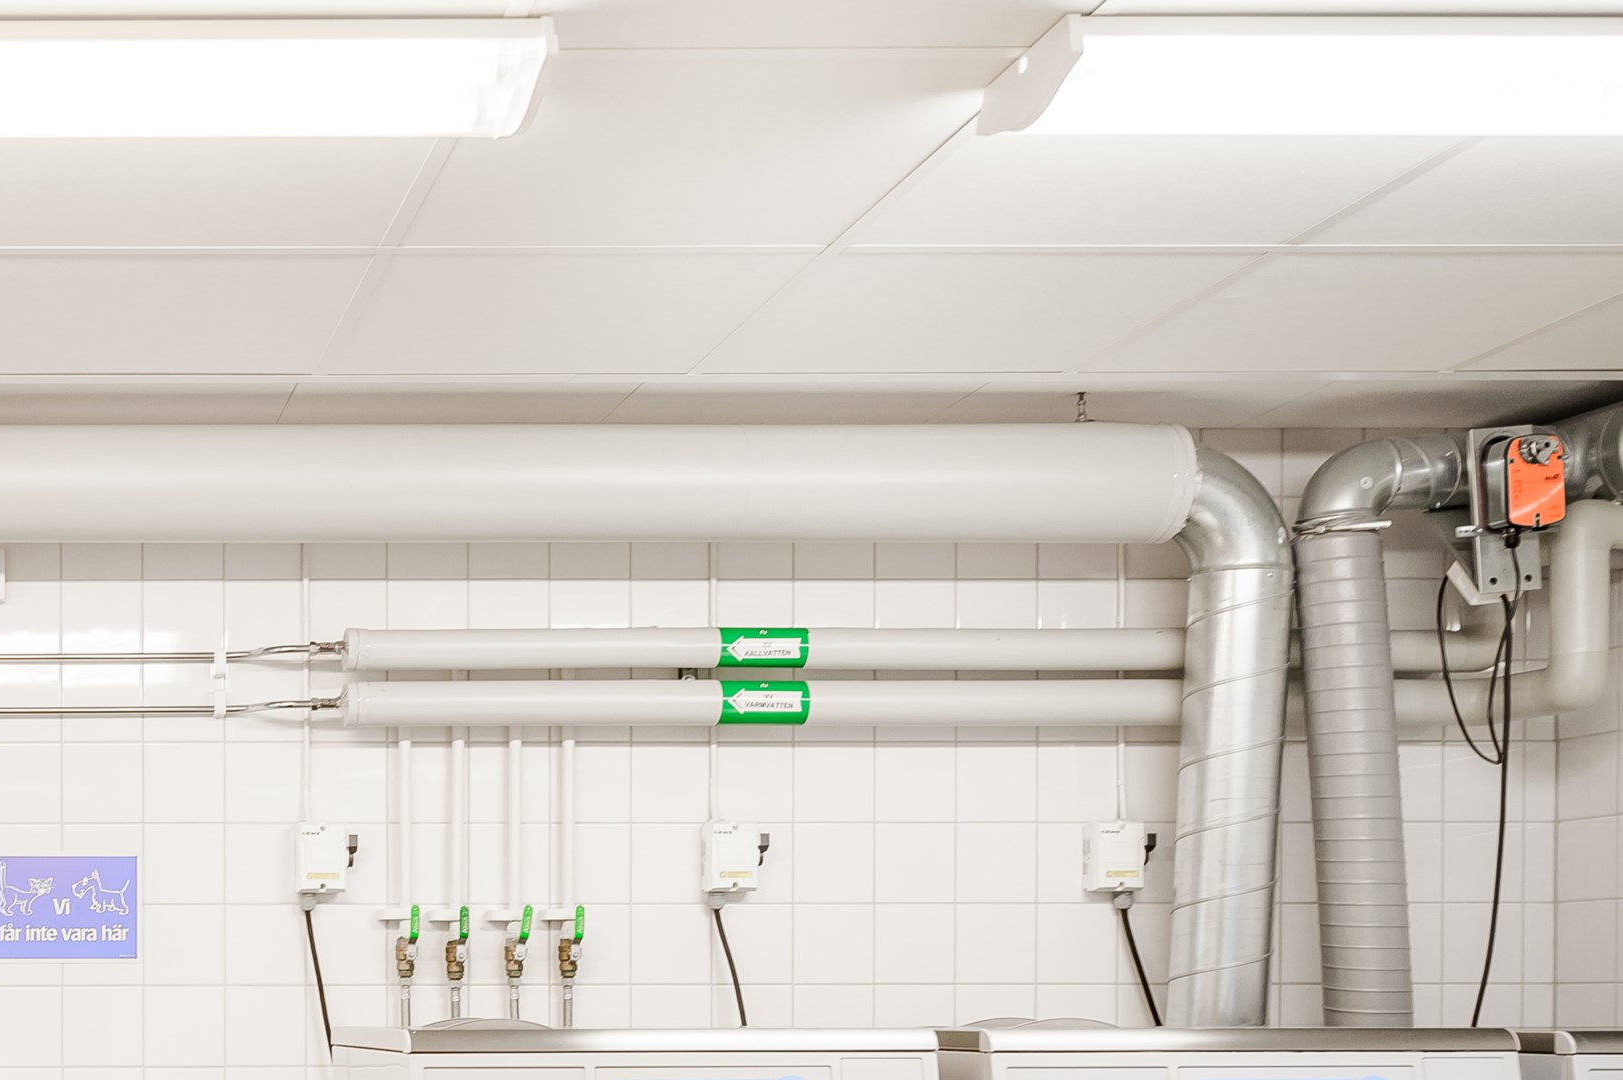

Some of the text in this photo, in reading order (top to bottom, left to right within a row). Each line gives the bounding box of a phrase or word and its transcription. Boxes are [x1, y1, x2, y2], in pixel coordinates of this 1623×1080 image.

[52, 898, 71, 915] Vi
[25, 925, 58, 942] inte
[61, 927, 97, 942] vara
[100, 924, 129, 942] här
